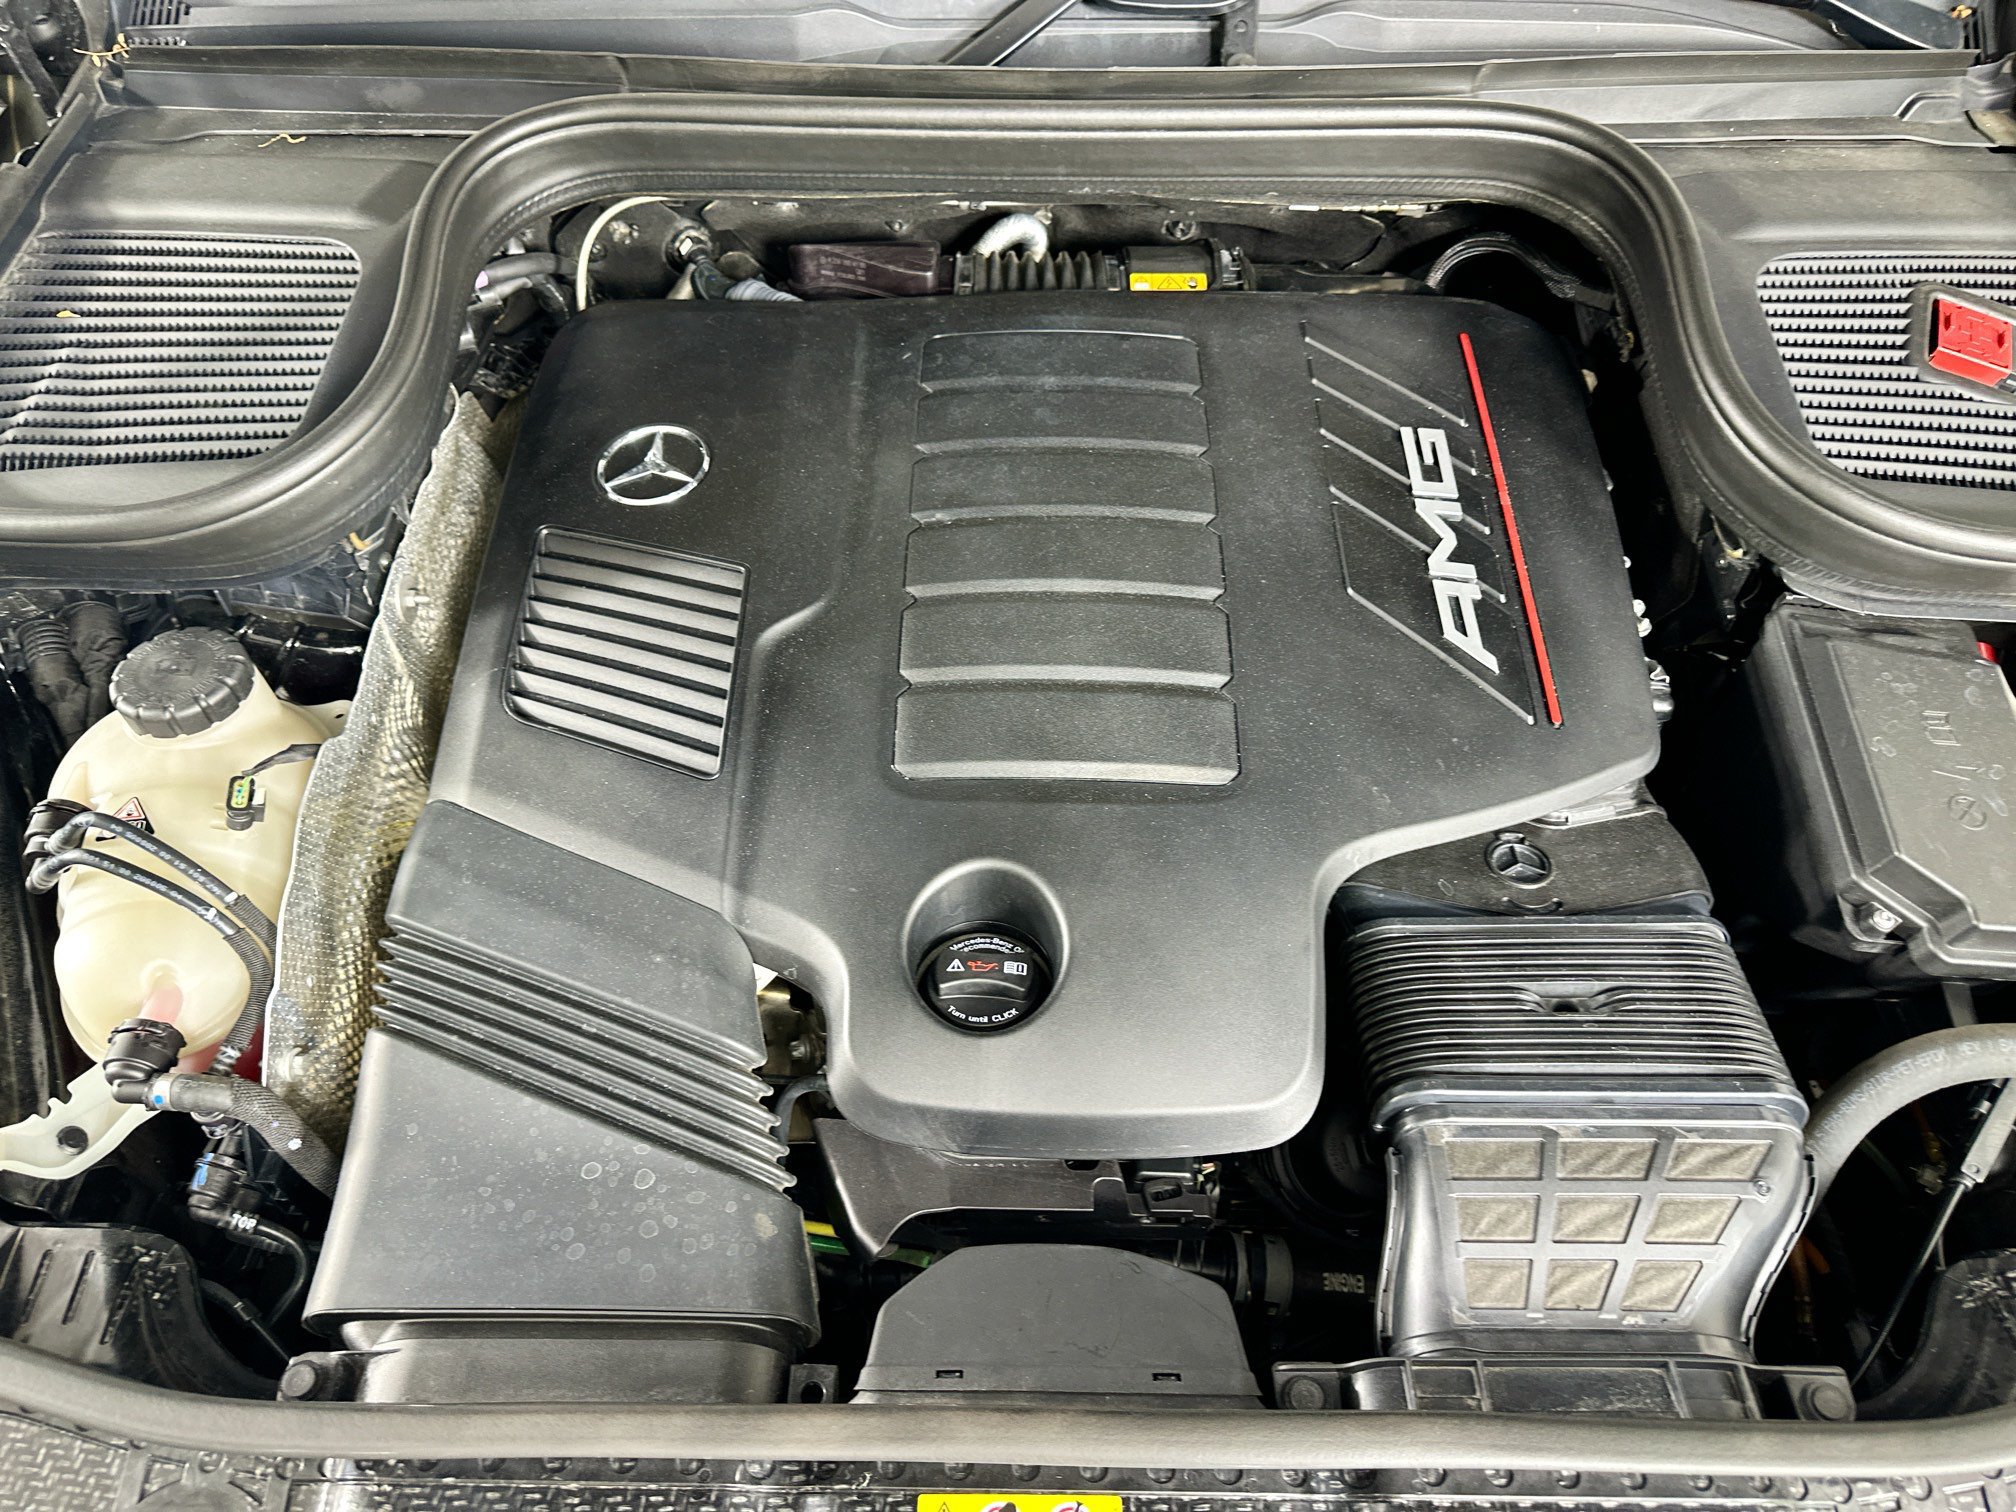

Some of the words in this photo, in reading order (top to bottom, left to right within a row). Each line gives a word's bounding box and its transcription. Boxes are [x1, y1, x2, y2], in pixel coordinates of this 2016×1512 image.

[1400, 426, 1499, 675] AMG
[947, 1004, 966, 1020] Turn
[968, 1015, 988, 1023] until
[991, 1007, 1019, 1022] CLICK
[231, 1212, 258, 1230] TOP
